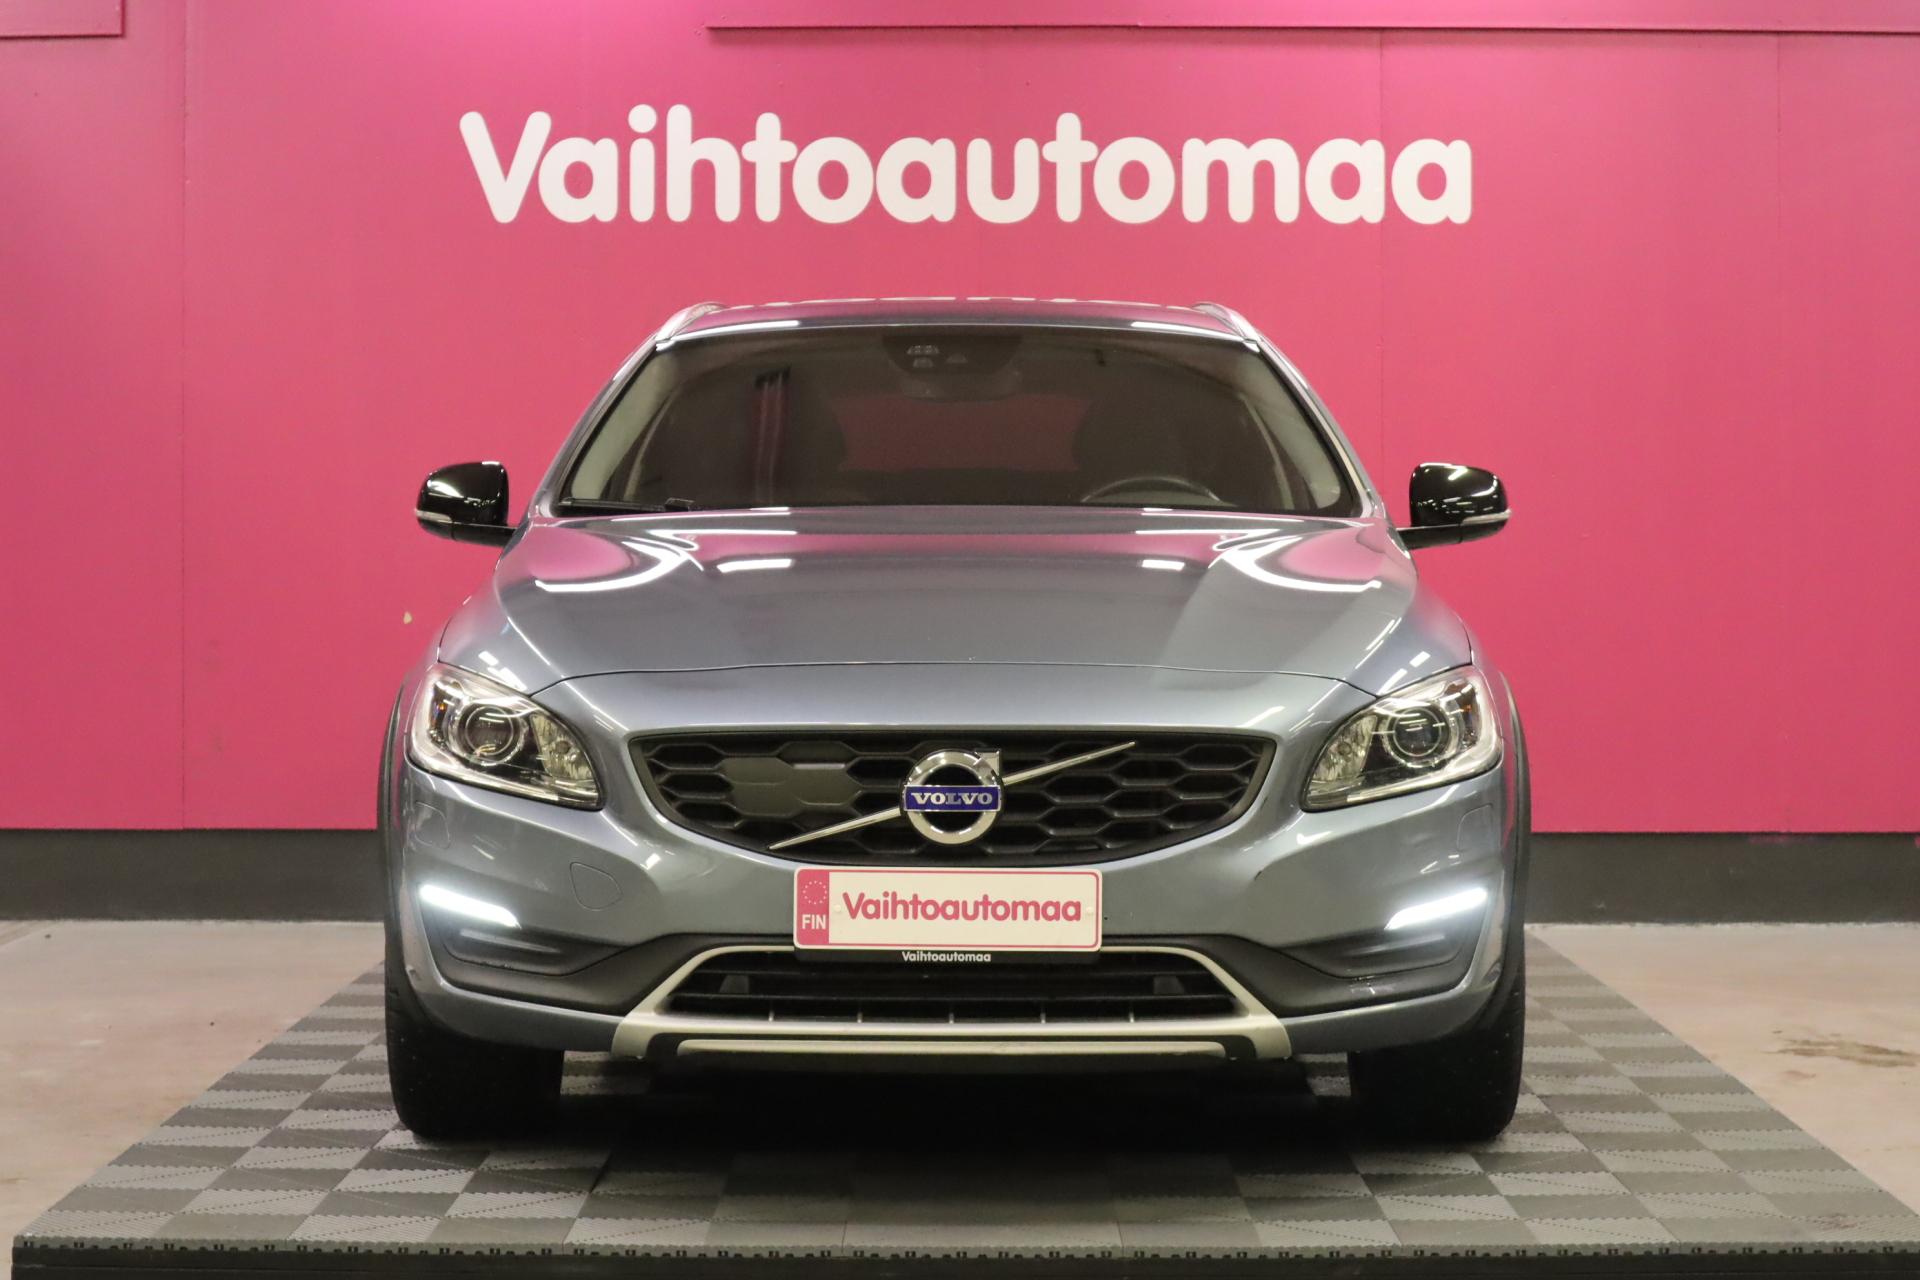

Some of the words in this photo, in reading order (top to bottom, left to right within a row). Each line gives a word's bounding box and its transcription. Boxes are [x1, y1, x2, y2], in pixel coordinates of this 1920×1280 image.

[459, 103, 1472, 224] Vaihtoautomaa
[911, 791, 993, 806] VOLVO
[842, 891, 1082, 922] Vaihtoautomaa
[801, 914, 827, 930] FIN
[902, 951, 991, 963] Vaihtoautomaa
